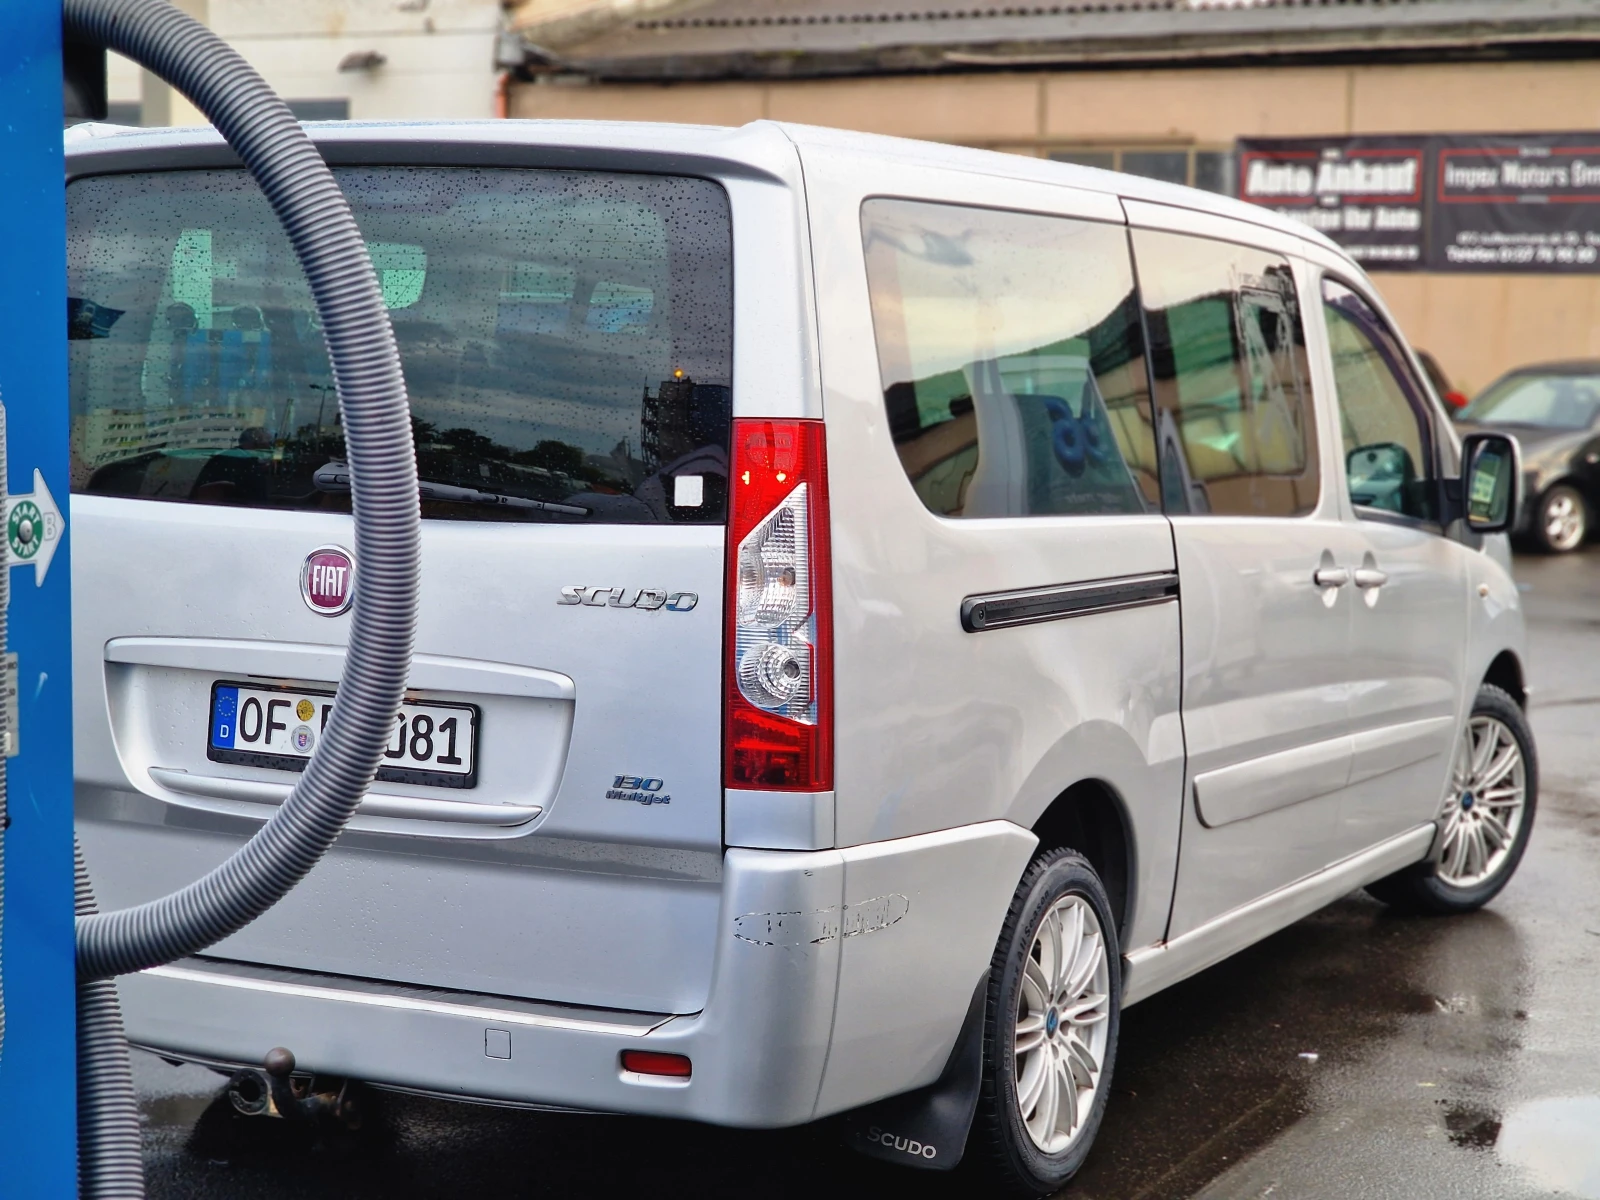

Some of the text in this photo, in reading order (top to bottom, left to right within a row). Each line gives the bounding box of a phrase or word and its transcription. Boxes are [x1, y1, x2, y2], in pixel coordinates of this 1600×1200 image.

[12, 503, 40, 524] START
[43, 512, 57, 541] B
[12, 535, 39, 556] START
[312, 565, 346, 597] FIAT
[557, 585, 698, 612] SCUDO
[219, 725, 229, 738] D
[239, 696, 291, 745] OF
[613, 774, 663, 791] 130
[1024, 890, 1050, 938] Season
[867, 1126, 937, 1159] SCUDO
